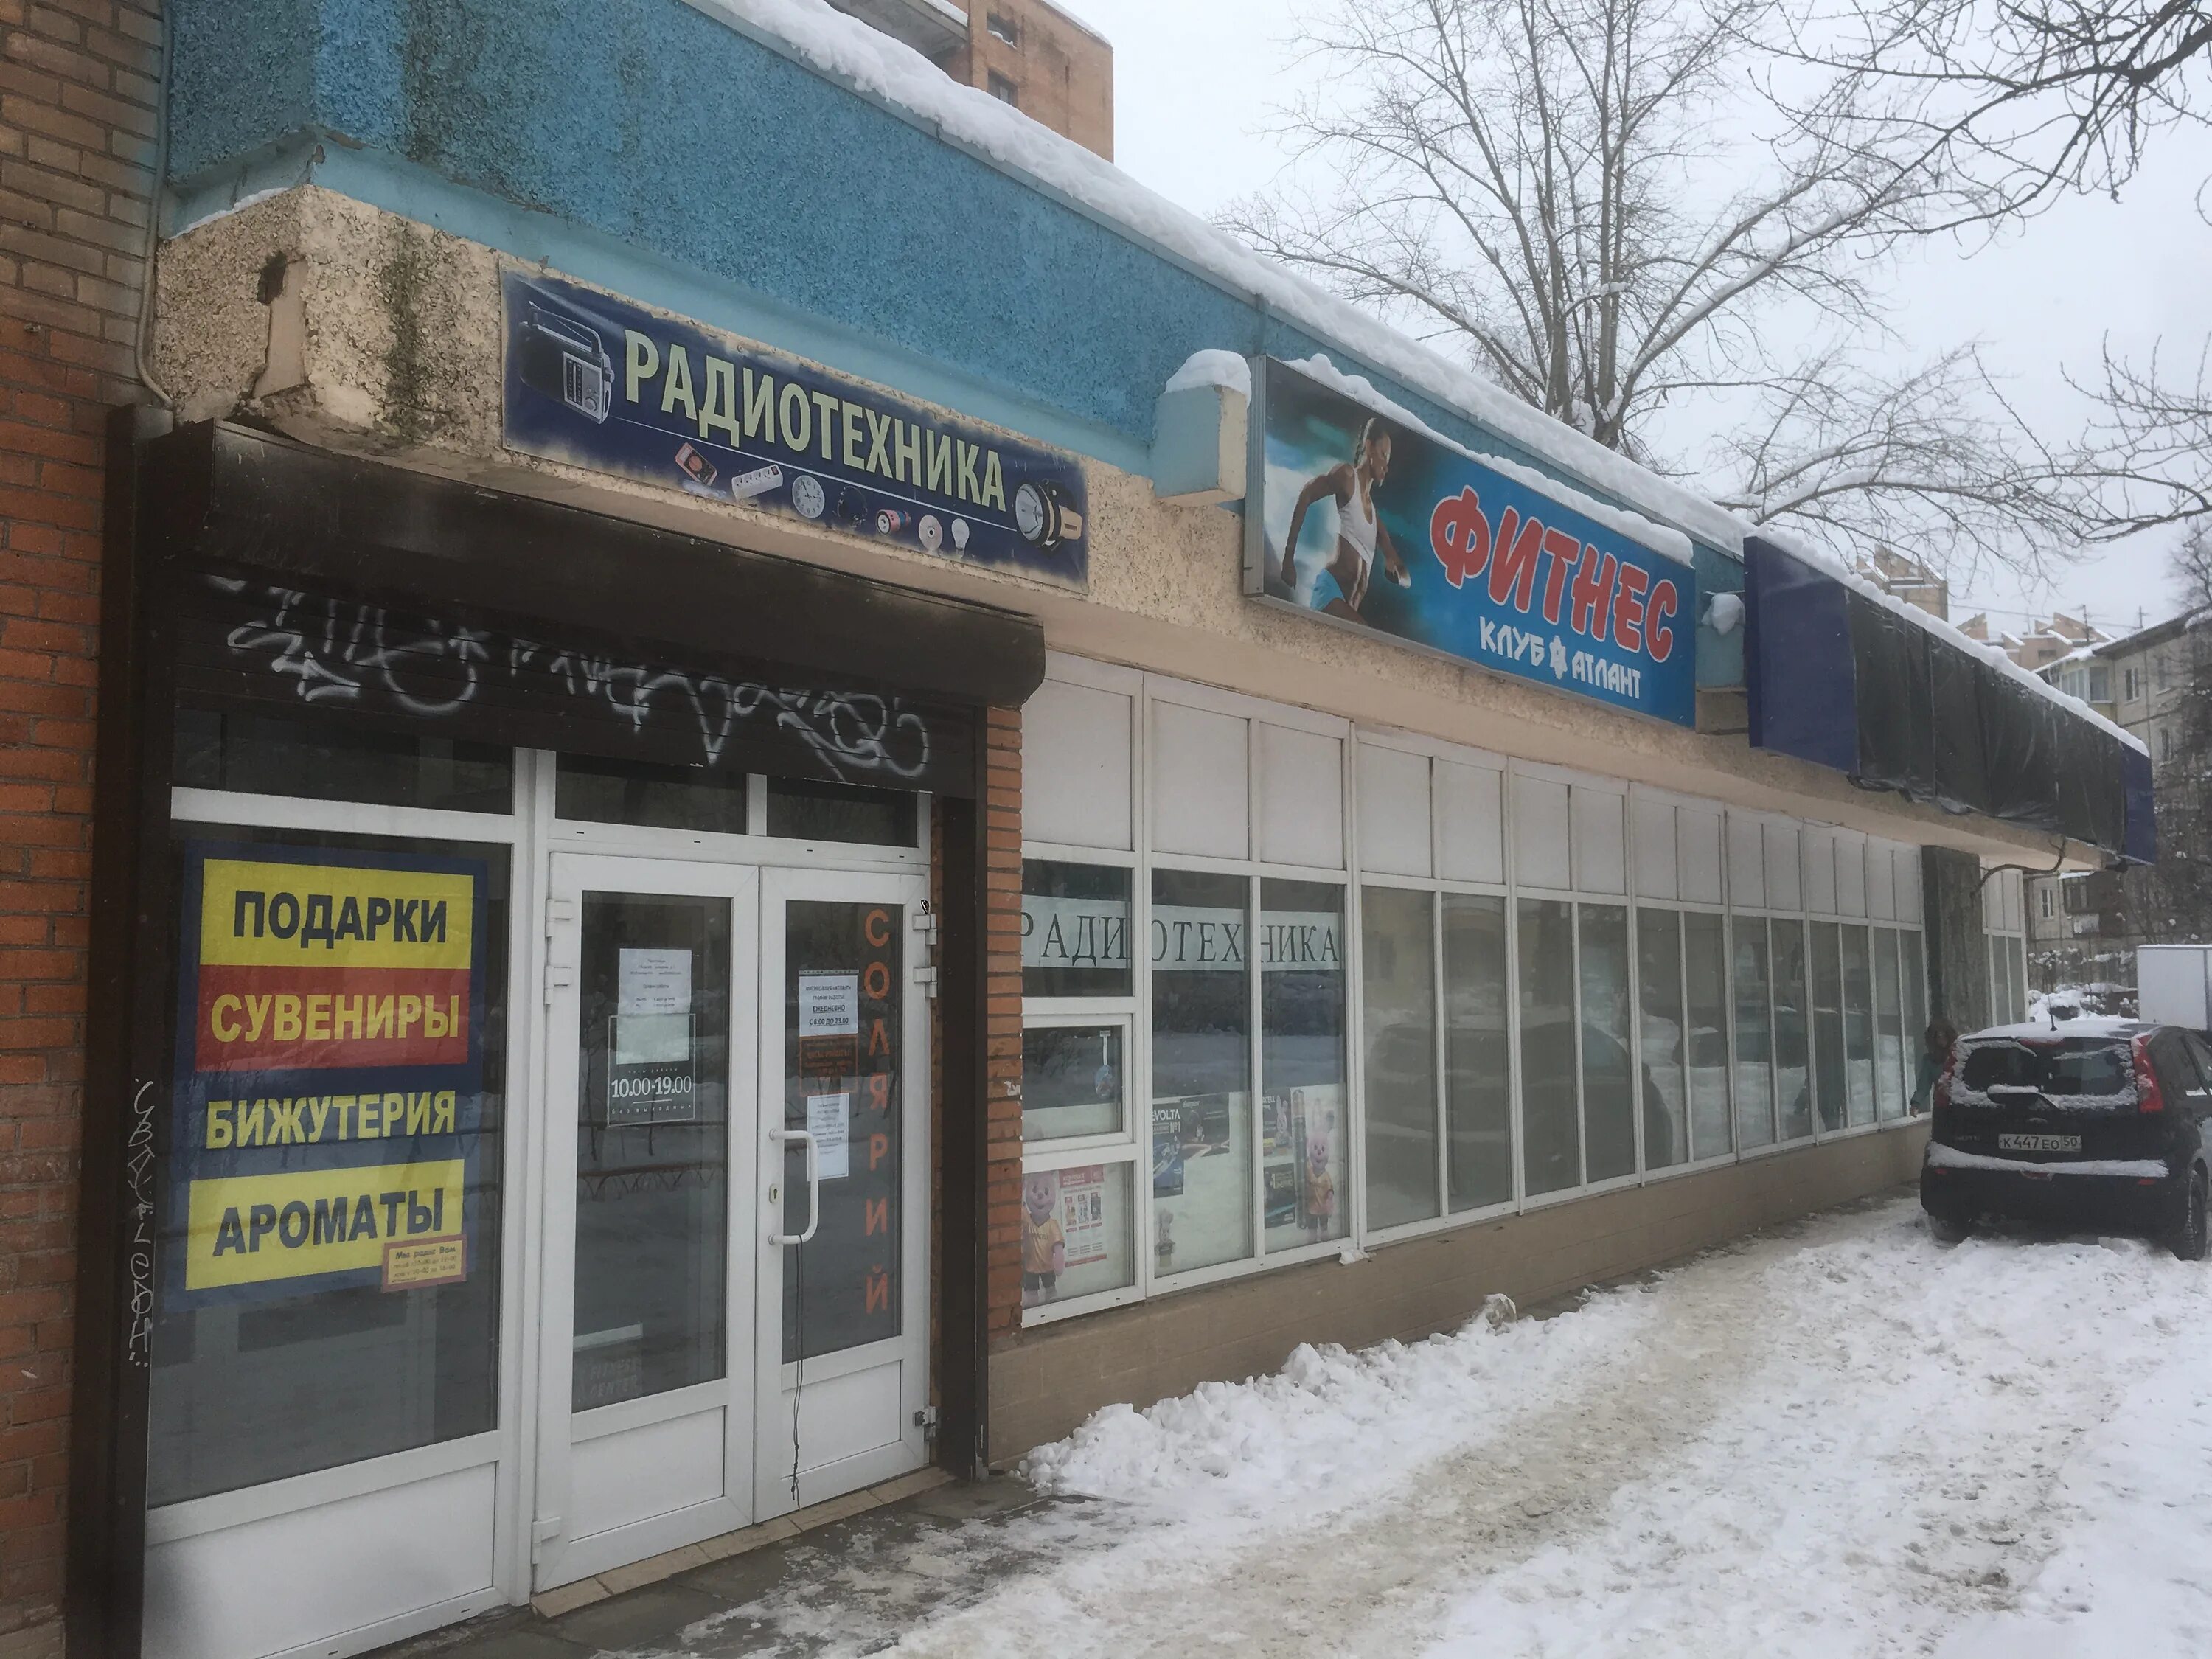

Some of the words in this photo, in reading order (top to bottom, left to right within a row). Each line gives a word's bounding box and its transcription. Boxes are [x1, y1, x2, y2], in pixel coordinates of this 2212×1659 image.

[625, 329, 1007, 512] РАДИОТЕХНИКА
[1430, 484, 1677, 663] ФИТНЕС
[1479, 616, 1545, 667] КЛУБ
[1571, 650, 1641, 699] АТЛАНТ
[234, 890, 447, 949] ПОДАРКИ
[212, 995, 459, 1042] СУВЕНИРЫ
[813, 1004, 846, 1013] ЕЖЕДНЕВНО
[611, 1075, 692, 1098] 10.00-19.00
[864, 908, 890, 1315] СОЛЯРИЙ
[206, 1091, 456, 1150] БИЖУТЕРИЯ
[212, 1188, 443, 1256] АРОМАТЫ
[439, 1246, 456, 1254] Вам
